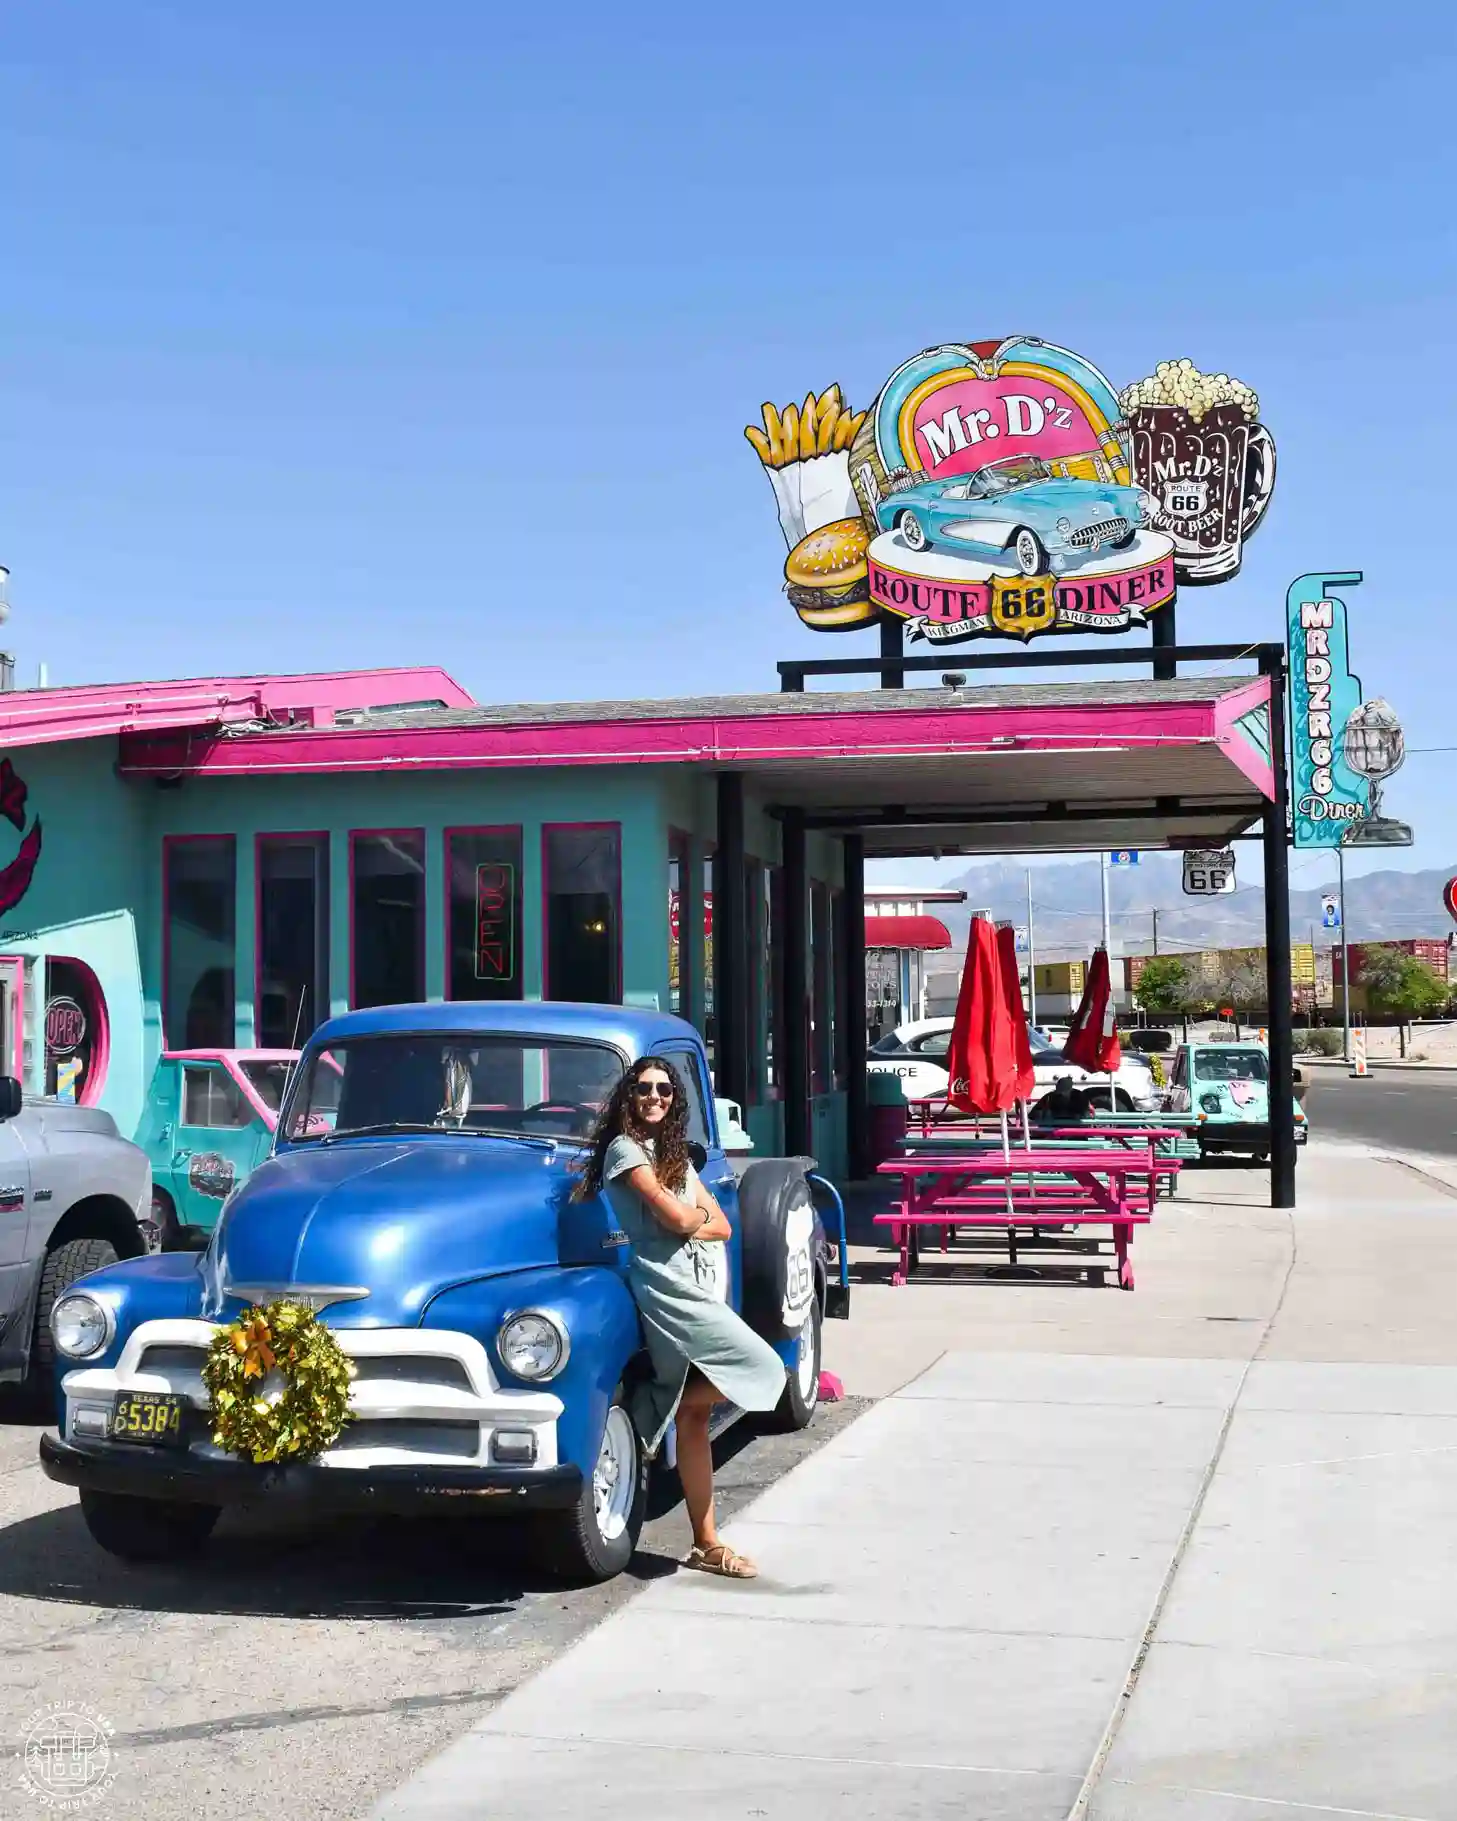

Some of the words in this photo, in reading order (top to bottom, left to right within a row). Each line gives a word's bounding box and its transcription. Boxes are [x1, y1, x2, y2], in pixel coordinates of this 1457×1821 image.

[917, 405, 1000, 469] Mr.
[997, 394, 1073, 437] D'z
[1152, 456, 1192, 482] Mr.
[1172, 495, 1199, 511] 66
[1188, 508, 1223, 533] BEER
[874, 570, 981, 619] ROUTE
[1002, 588, 1046, 618] 66
[1057, 567, 1168, 611] DINER
[928, 617, 986, 637] KINGMAN
[1061, 612, 1124, 626] ARIZONA
[1298, 793, 1365, 821] Diner
[1190, 870, 1226, 890] 66
[480, 867, 505, 973] OPEN
[47, 1008, 83, 1045] OPEN
[127, 1403, 181, 1433] 5384
